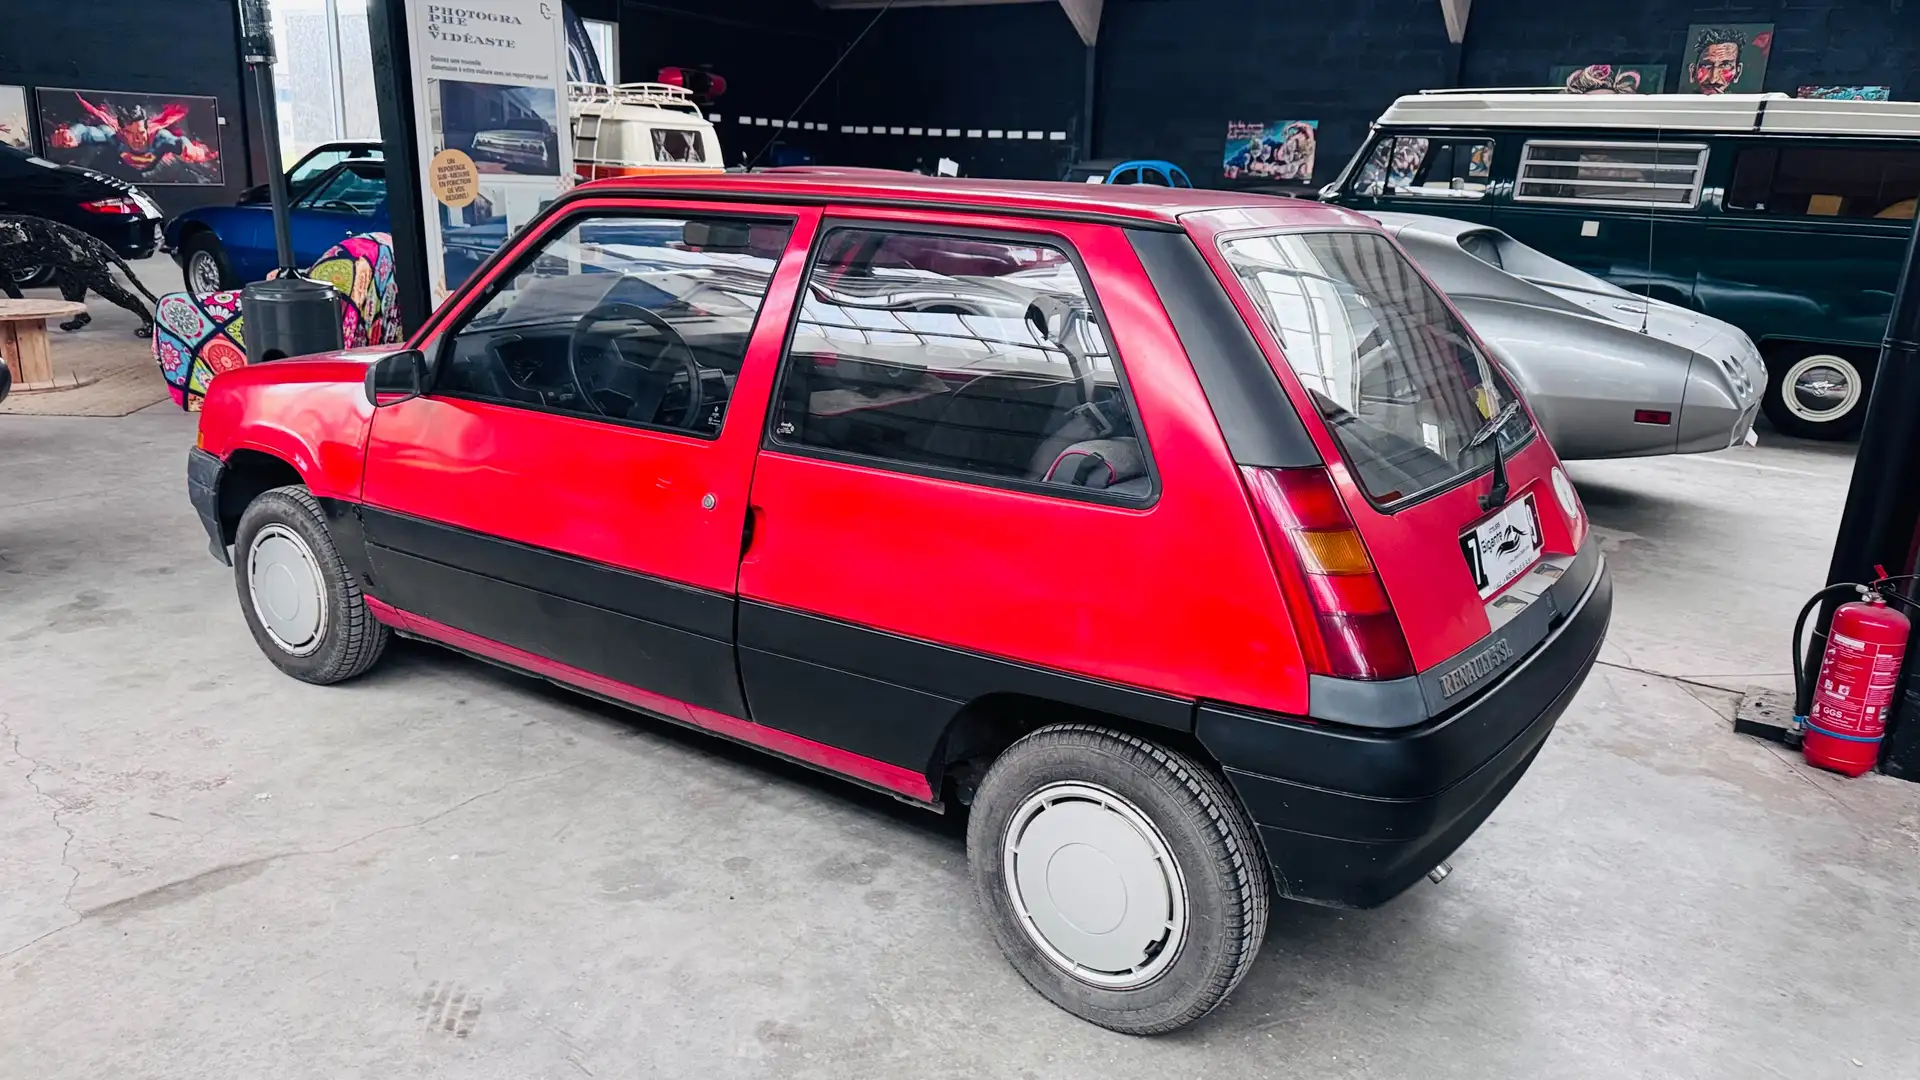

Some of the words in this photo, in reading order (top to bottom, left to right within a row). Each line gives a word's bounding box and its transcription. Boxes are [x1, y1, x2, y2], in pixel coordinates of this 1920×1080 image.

[428, 5, 522, 26] PHOTOGRA
[429, 14, 468, 27] PHE
[428, 23, 440, 31] &
[428, 31, 516, 49] VIDÉASTE
[1438, 649, 1493, 699] RENAULT
[1823, 706, 1843, 719] GGS
